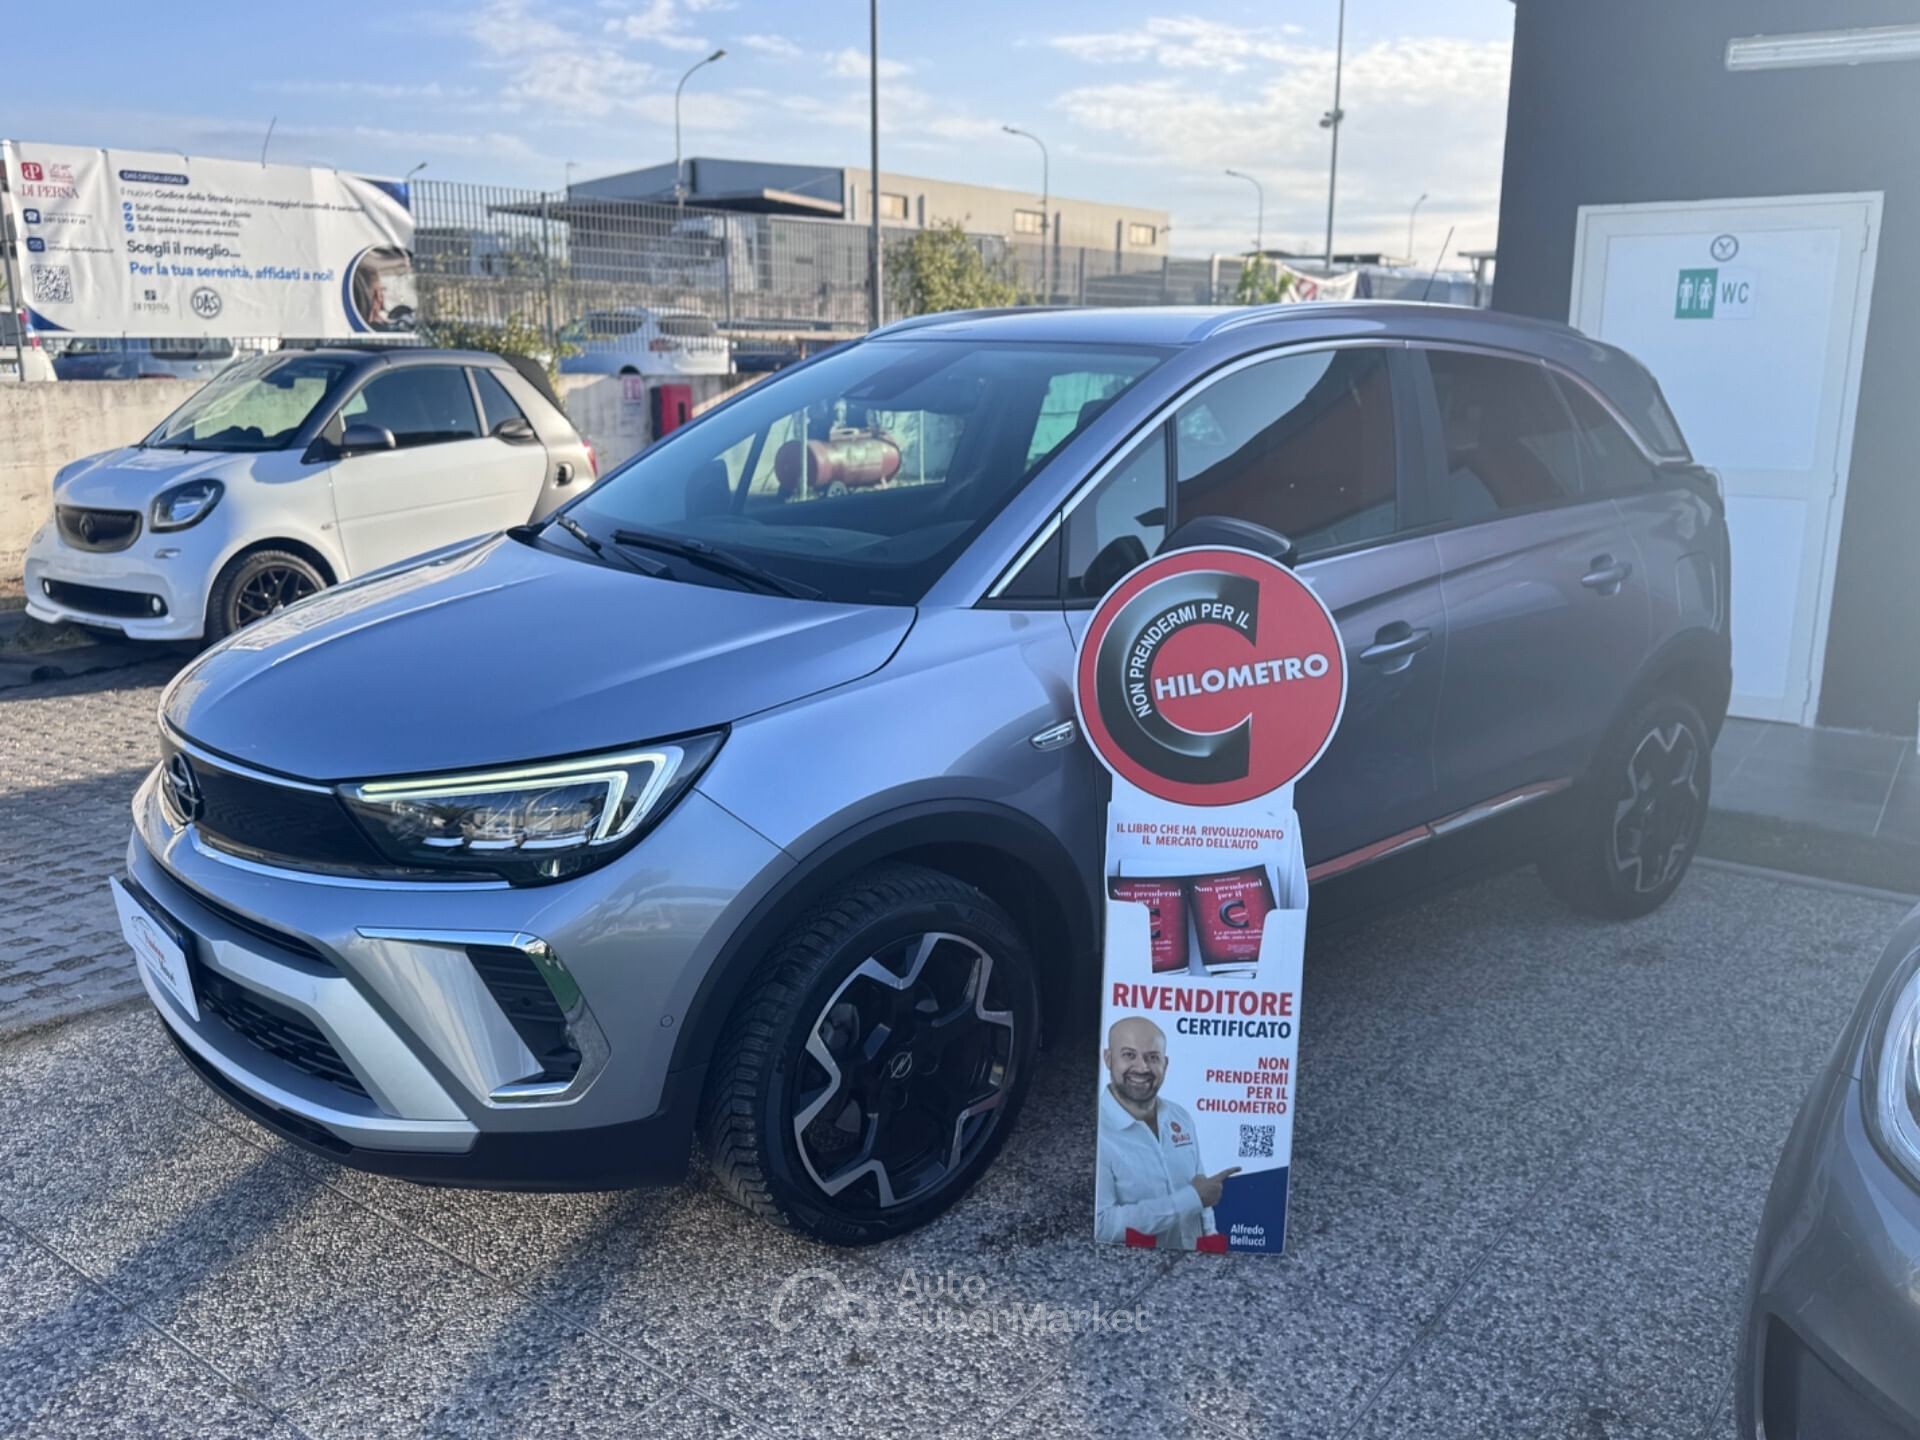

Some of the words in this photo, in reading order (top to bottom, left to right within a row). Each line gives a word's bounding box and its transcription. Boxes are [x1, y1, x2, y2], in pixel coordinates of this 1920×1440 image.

[126, 239, 171, 258] Scegli
[173, 241, 181, 254] il
[129, 261, 153, 275] Per
[157, 263, 169, 276] la
[171, 264, 193, 277] tua
[197, 264, 253, 280] serenità,
[255, 267, 300, 281] affidati
[303, 271, 311, 281] a
[1722, 281, 1750, 304] WC
[195, 294, 218, 314] DAS
[1202, 603, 1233, 621] PER
[1236, 610, 1250, 630] IL
[1130, 604, 1198, 679] PRENDERMI
[1130, 684, 1153, 719] NON
[1116, 823, 1126, 833] IL
[1127, 824, 1157, 834] LIBRO
[1160, 824, 1180, 835] CHE
[1182, 825, 1197, 836] HA
[1201, 826, 1284, 840] RIVOLUZIONATO
[1142, 835, 1151, 845] IL
[1155, 836, 1204, 847] MERCATO
[1206, 838, 1259, 850] DELL'AUTO
[1134, 888, 1182, 899] prendermi
[1194, 885, 1213, 893] Non
[1215, 879, 1263, 895] prendermi
[1217, 893, 1234, 901] per
[1112, 983, 1293, 1016] RIVENDITORE
[1176, 1017, 1292, 1039] CERTIFICATO
[1258, 1057, 1290, 1071] NON
[1206, 1070, 1289, 1085] PRENDERMI
[1247, 1087, 1273, 1100] PER
[1276, 1087, 1288, 1100] IL
[1196, 1098, 1287, 1115] CHILOMETRO
[1230, 1224, 1265, 1235] Alfredo
[1230, 1235, 1266, 1247] Bellucci
